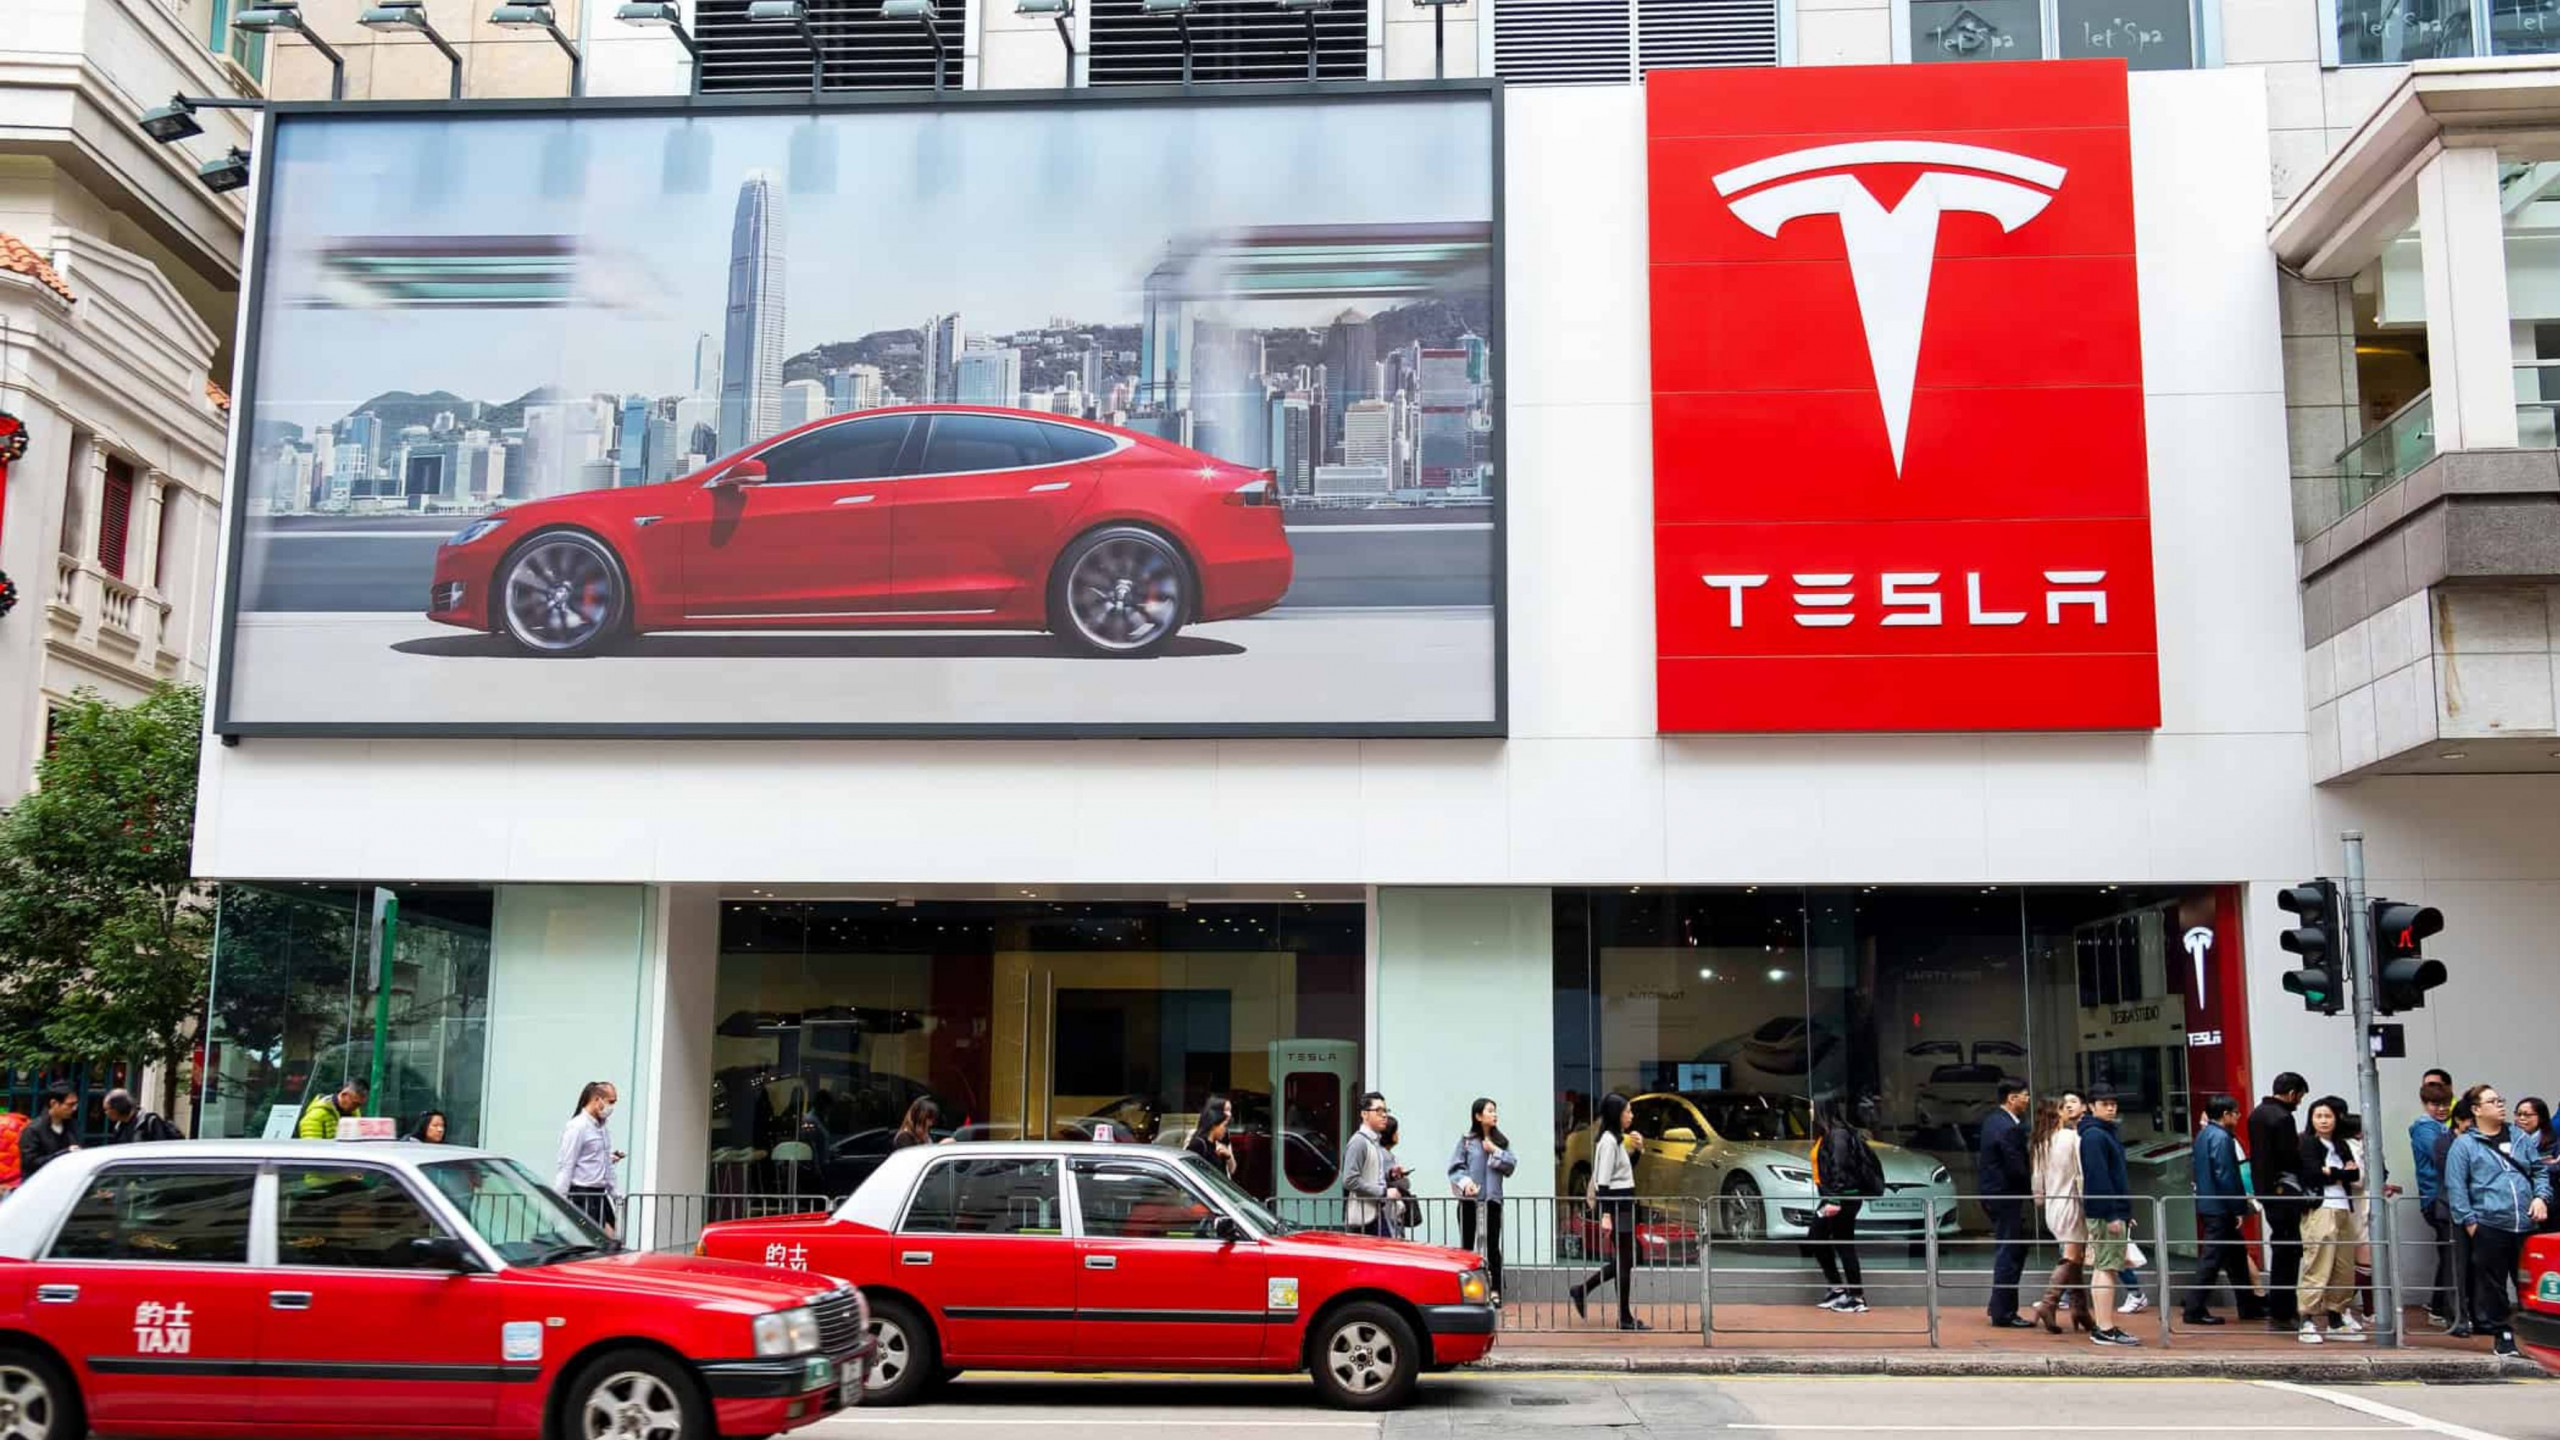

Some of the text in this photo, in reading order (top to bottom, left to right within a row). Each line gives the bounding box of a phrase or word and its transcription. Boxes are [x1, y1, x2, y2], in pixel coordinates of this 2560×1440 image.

[1702, 571, 2107, 627] TESLA
[2187, 1030, 2222, 1047] TESLA
[1287, 1053, 1337, 1061] TESLA
[765, 1243, 809, 1262] 的士
[135, 1300, 194, 1326] 的士
[133, 1327, 191, 1354] TAXI
